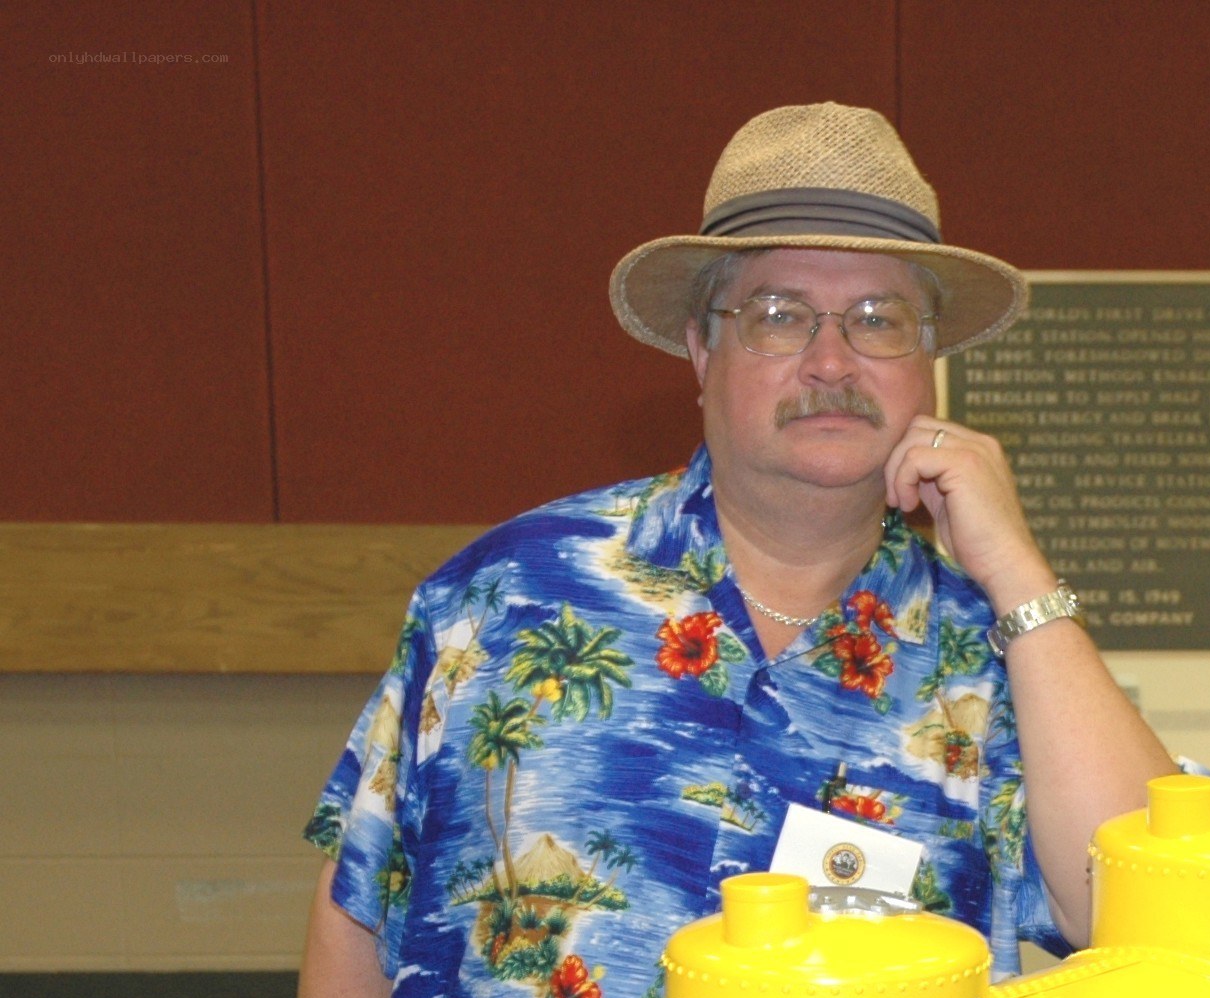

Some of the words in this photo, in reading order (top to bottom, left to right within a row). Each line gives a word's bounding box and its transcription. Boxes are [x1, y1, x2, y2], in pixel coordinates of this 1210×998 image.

[965, 390, 1059, 405] PETROLEUM
[1067, 390, 1090, 404] TO
[1109, 411, 1146, 425] AND
[1082, 452, 1120, 466] AND
[1074, 474, 1147, 488] SERVICE
[1080, 495, 1162, 509] PRODUCTS
[1050, 537, 1126, 551] FREEDOM
[1085, 559, 1124, 573] AND
[1110, 611, 1194, 626] COMPANY
